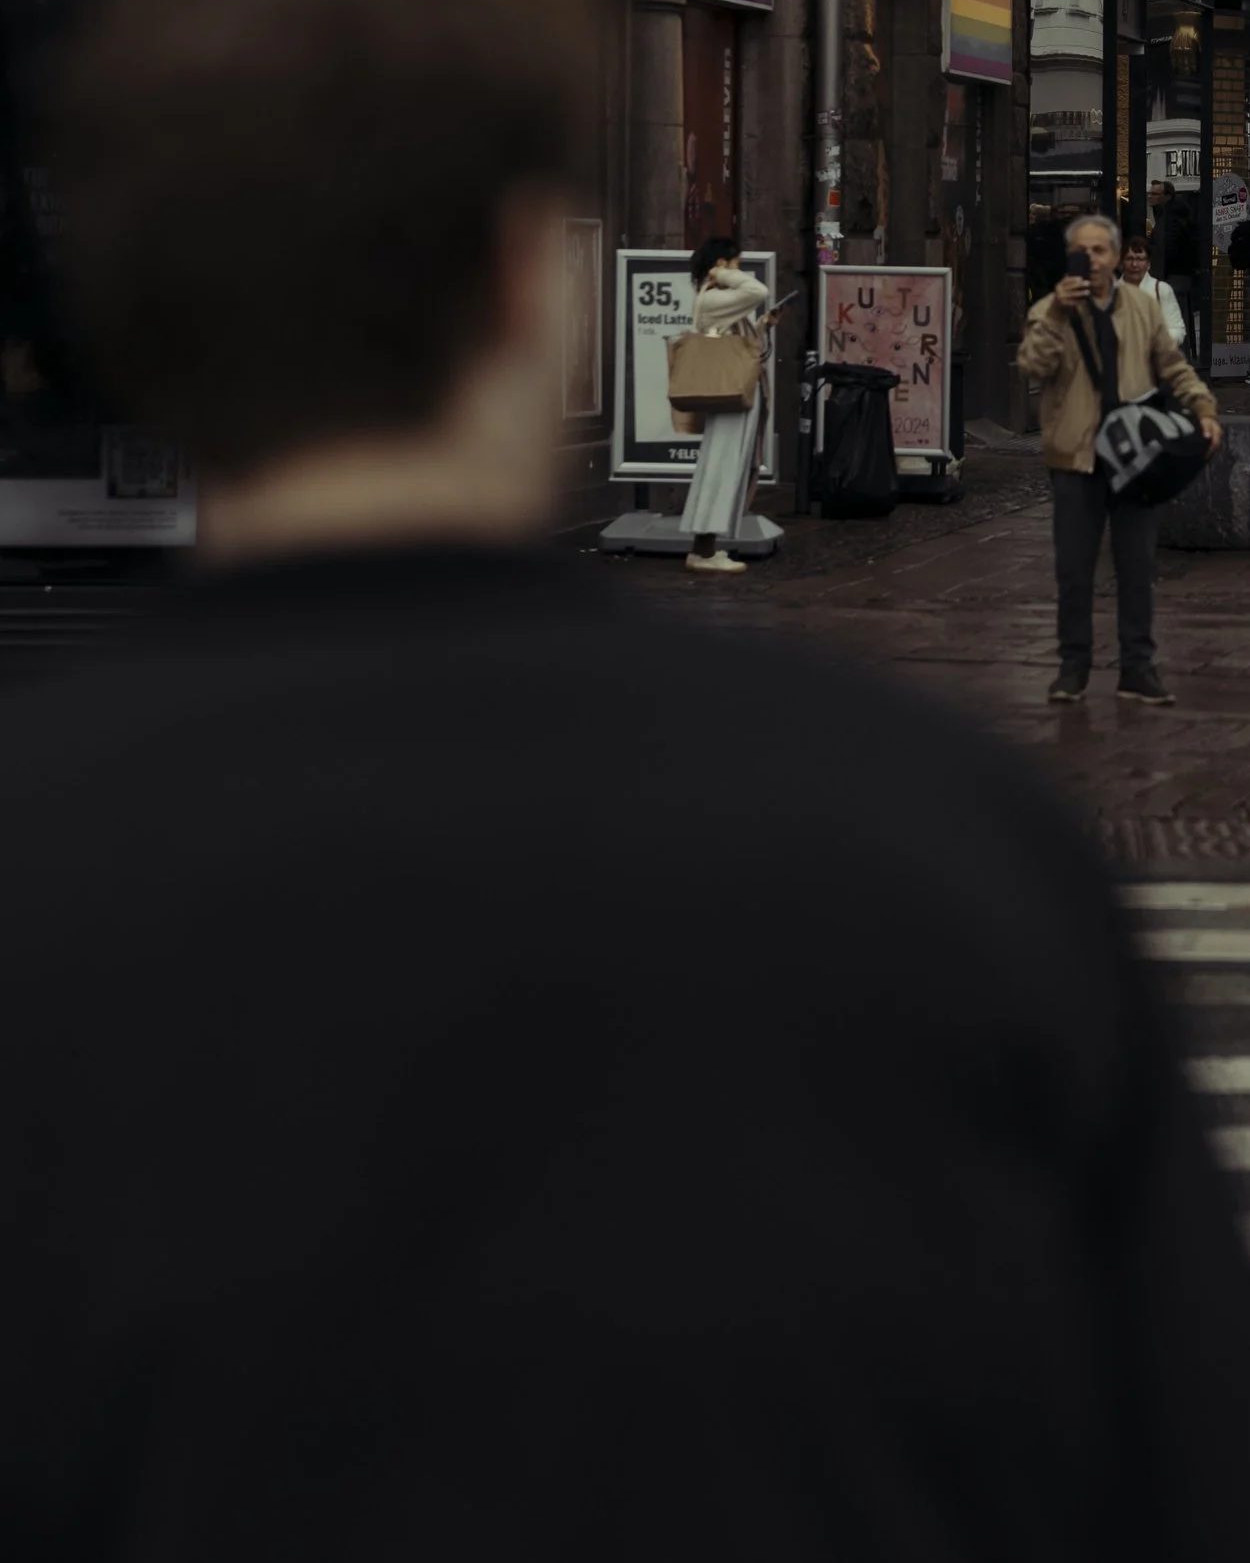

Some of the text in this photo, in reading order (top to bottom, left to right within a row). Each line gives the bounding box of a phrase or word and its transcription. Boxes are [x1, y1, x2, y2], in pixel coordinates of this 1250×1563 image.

[638, 314, 694, 325] Iced Latte
[895, 417, 930, 434] 2024
